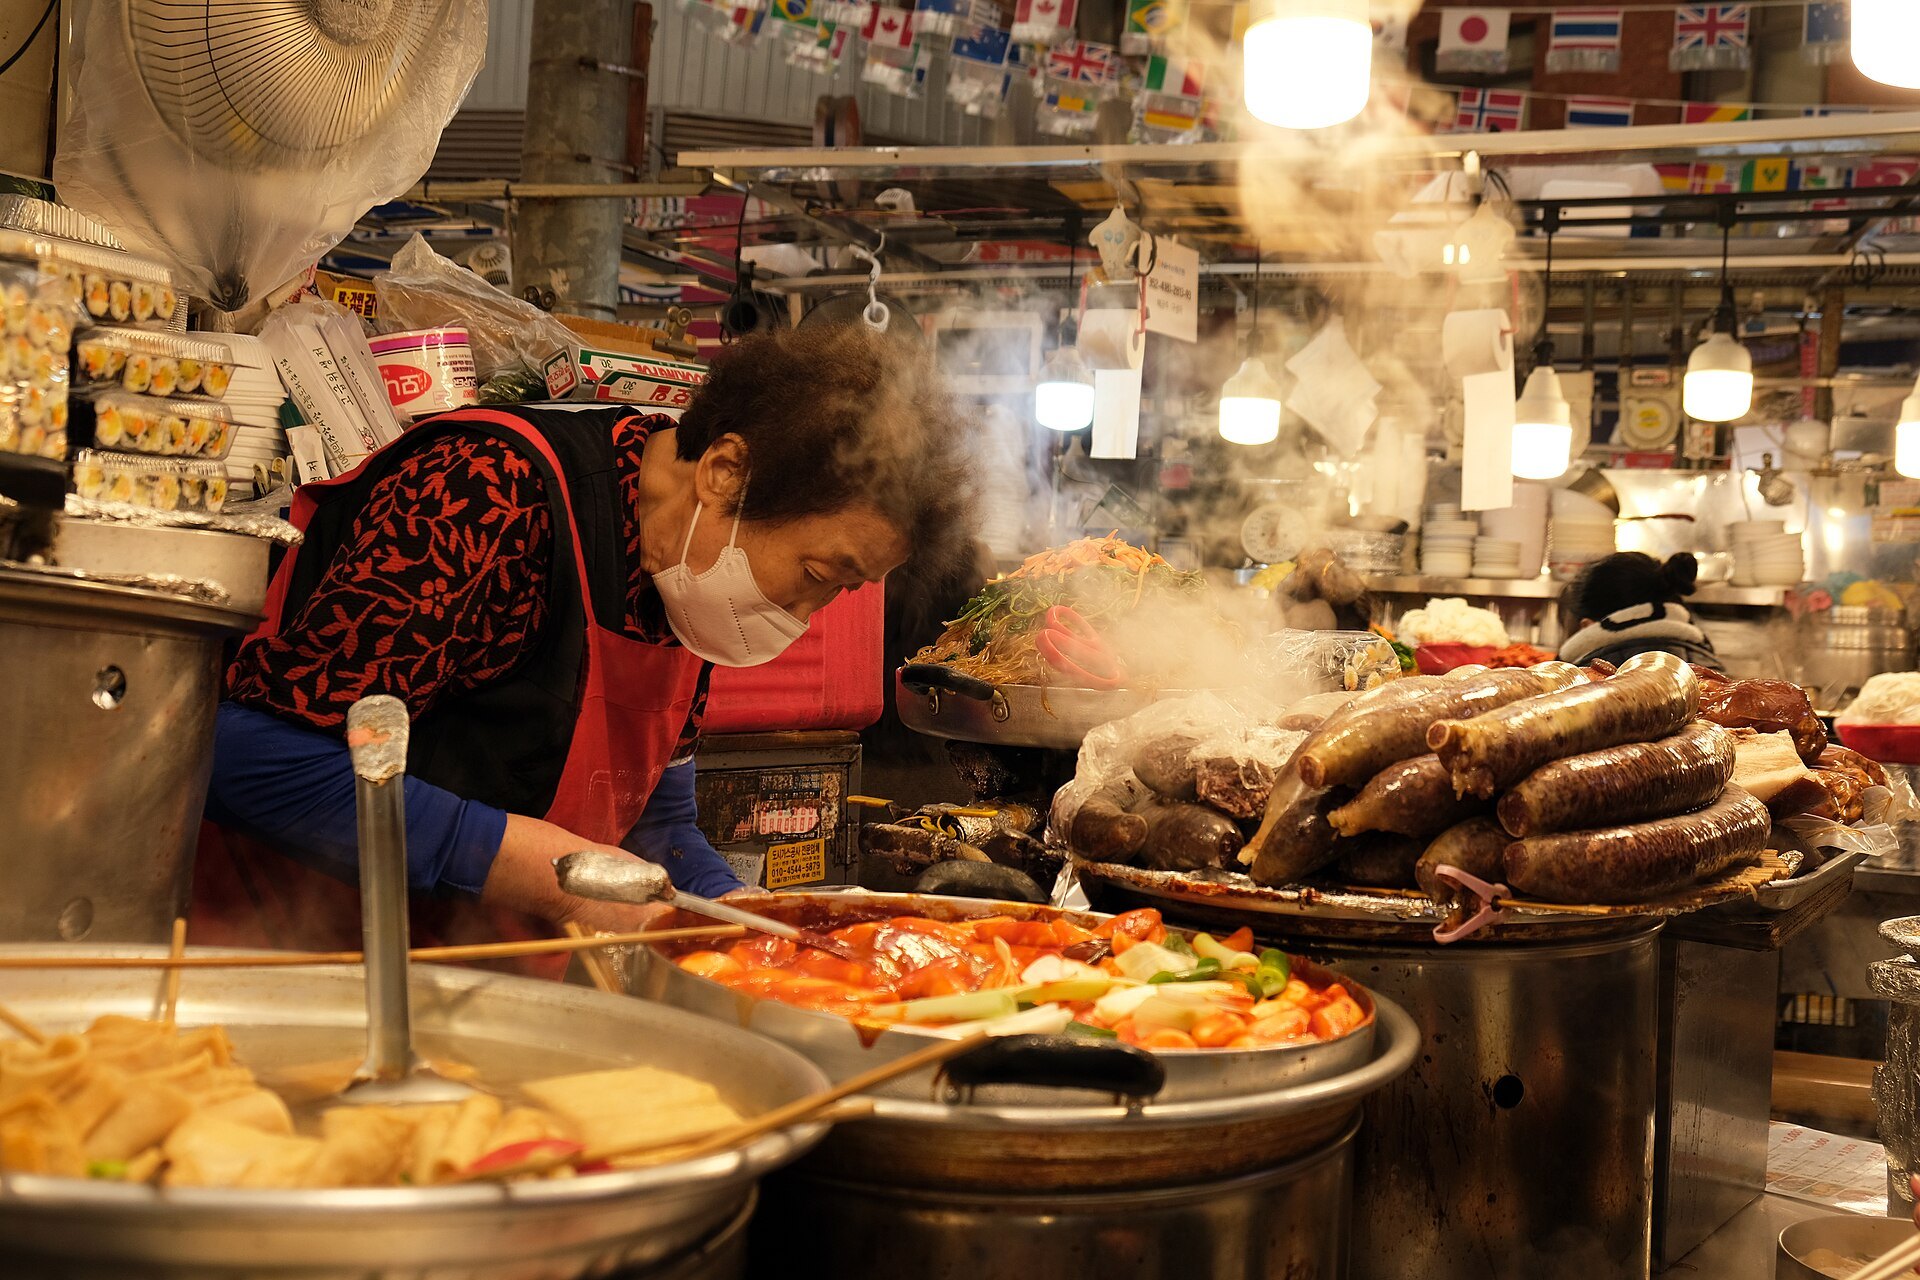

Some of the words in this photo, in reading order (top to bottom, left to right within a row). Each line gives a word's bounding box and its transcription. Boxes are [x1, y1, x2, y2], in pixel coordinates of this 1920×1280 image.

[452, 376, 477, 389] SUPER
[772, 846, 801, 860] 도시가스공사
[802, 842, 820, 856] 전문업체
[771, 861, 821, 878] 010-4544-5879
